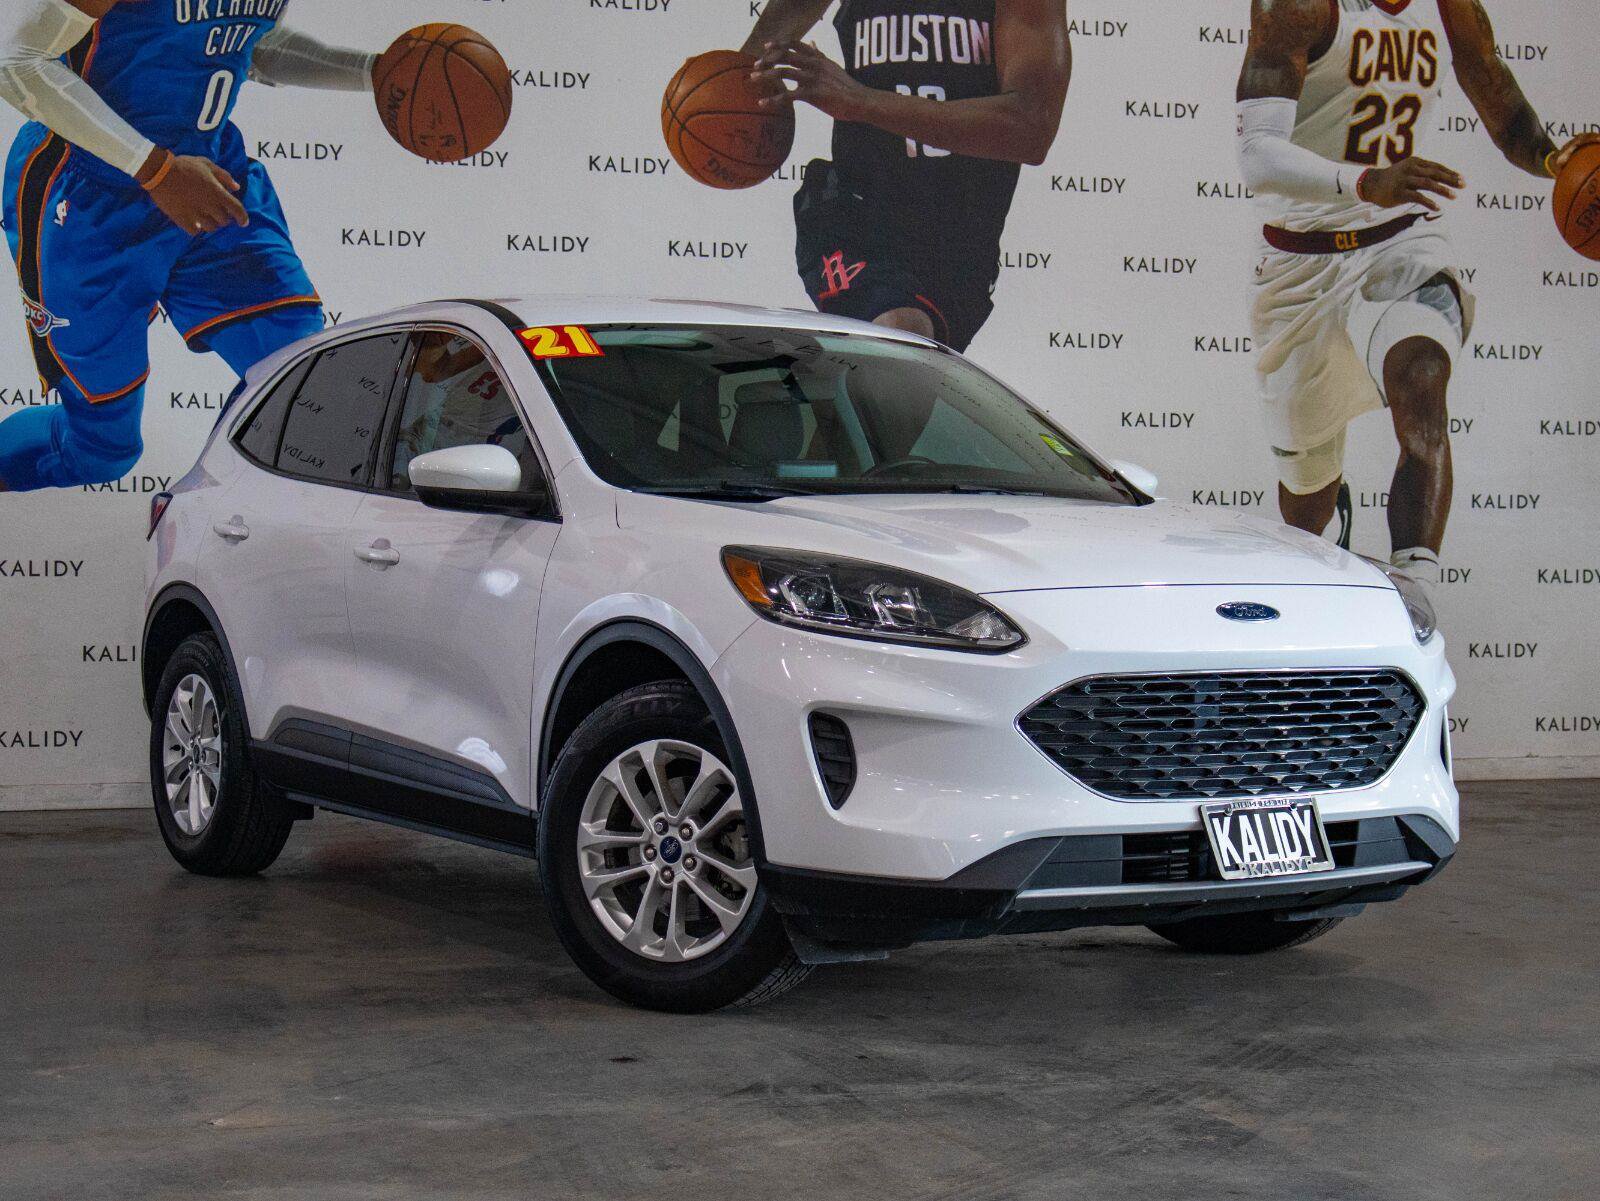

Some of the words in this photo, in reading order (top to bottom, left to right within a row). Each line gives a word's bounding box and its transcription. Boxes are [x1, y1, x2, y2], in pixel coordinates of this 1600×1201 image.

[1068, 19, 1128, 37] ALIDY
[1200, 26, 1251, 44] KALI
[205, 25, 257, 56] CITY
[854, 14, 992, 70] HOUSTON
[1347, 28, 1438, 89] CAVS
[1495, 44, 1548, 61] ALIDY
[509, 69, 590, 89] KALIDY
[197, 69, 234, 131] 0
[1125, 101, 1199, 119] KALIDY
[1343, 92, 1422, 166] 23
[257, 141, 344, 161] KALIDY
[588, 155, 671, 175] KALIDY
[1051, 176, 1126, 194] KALIDY
[1476, 194, 1546, 211] KALIDY
[342, 228, 426, 248] KALIDY
[507, 234, 590, 253] KALIDY
[1335, 230, 1359, 250] CLE
[668, 240, 748, 259] KALIDY
[1004, 252, 1052, 269] LIDY
[1123, 256, 1197, 274] KALIDY
[1543, 270, 1600, 287] KALID
[520, 325, 600, 357] 21
[1049, 331, 1124, 349] KALIDY
[1194, 336, 1252, 353] KALID
[1473, 344, 1543, 360] KALIDY
[170, 391, 224, 409] KALI
[1121, 411, 1195, 429] KALIDY
[1540, 419, 1600, 436] KALID
[1192, 489, 1265, 507] KALIDY
[1471, 493, 1541, 509] KALIDY
[82, 645, 136, 662] KALI
[1468, 642, 1538, 658] KALIDY
[1535, 716, 1600, 732] KALIDY
[1211, 808, 1317, 867] KALIDY
